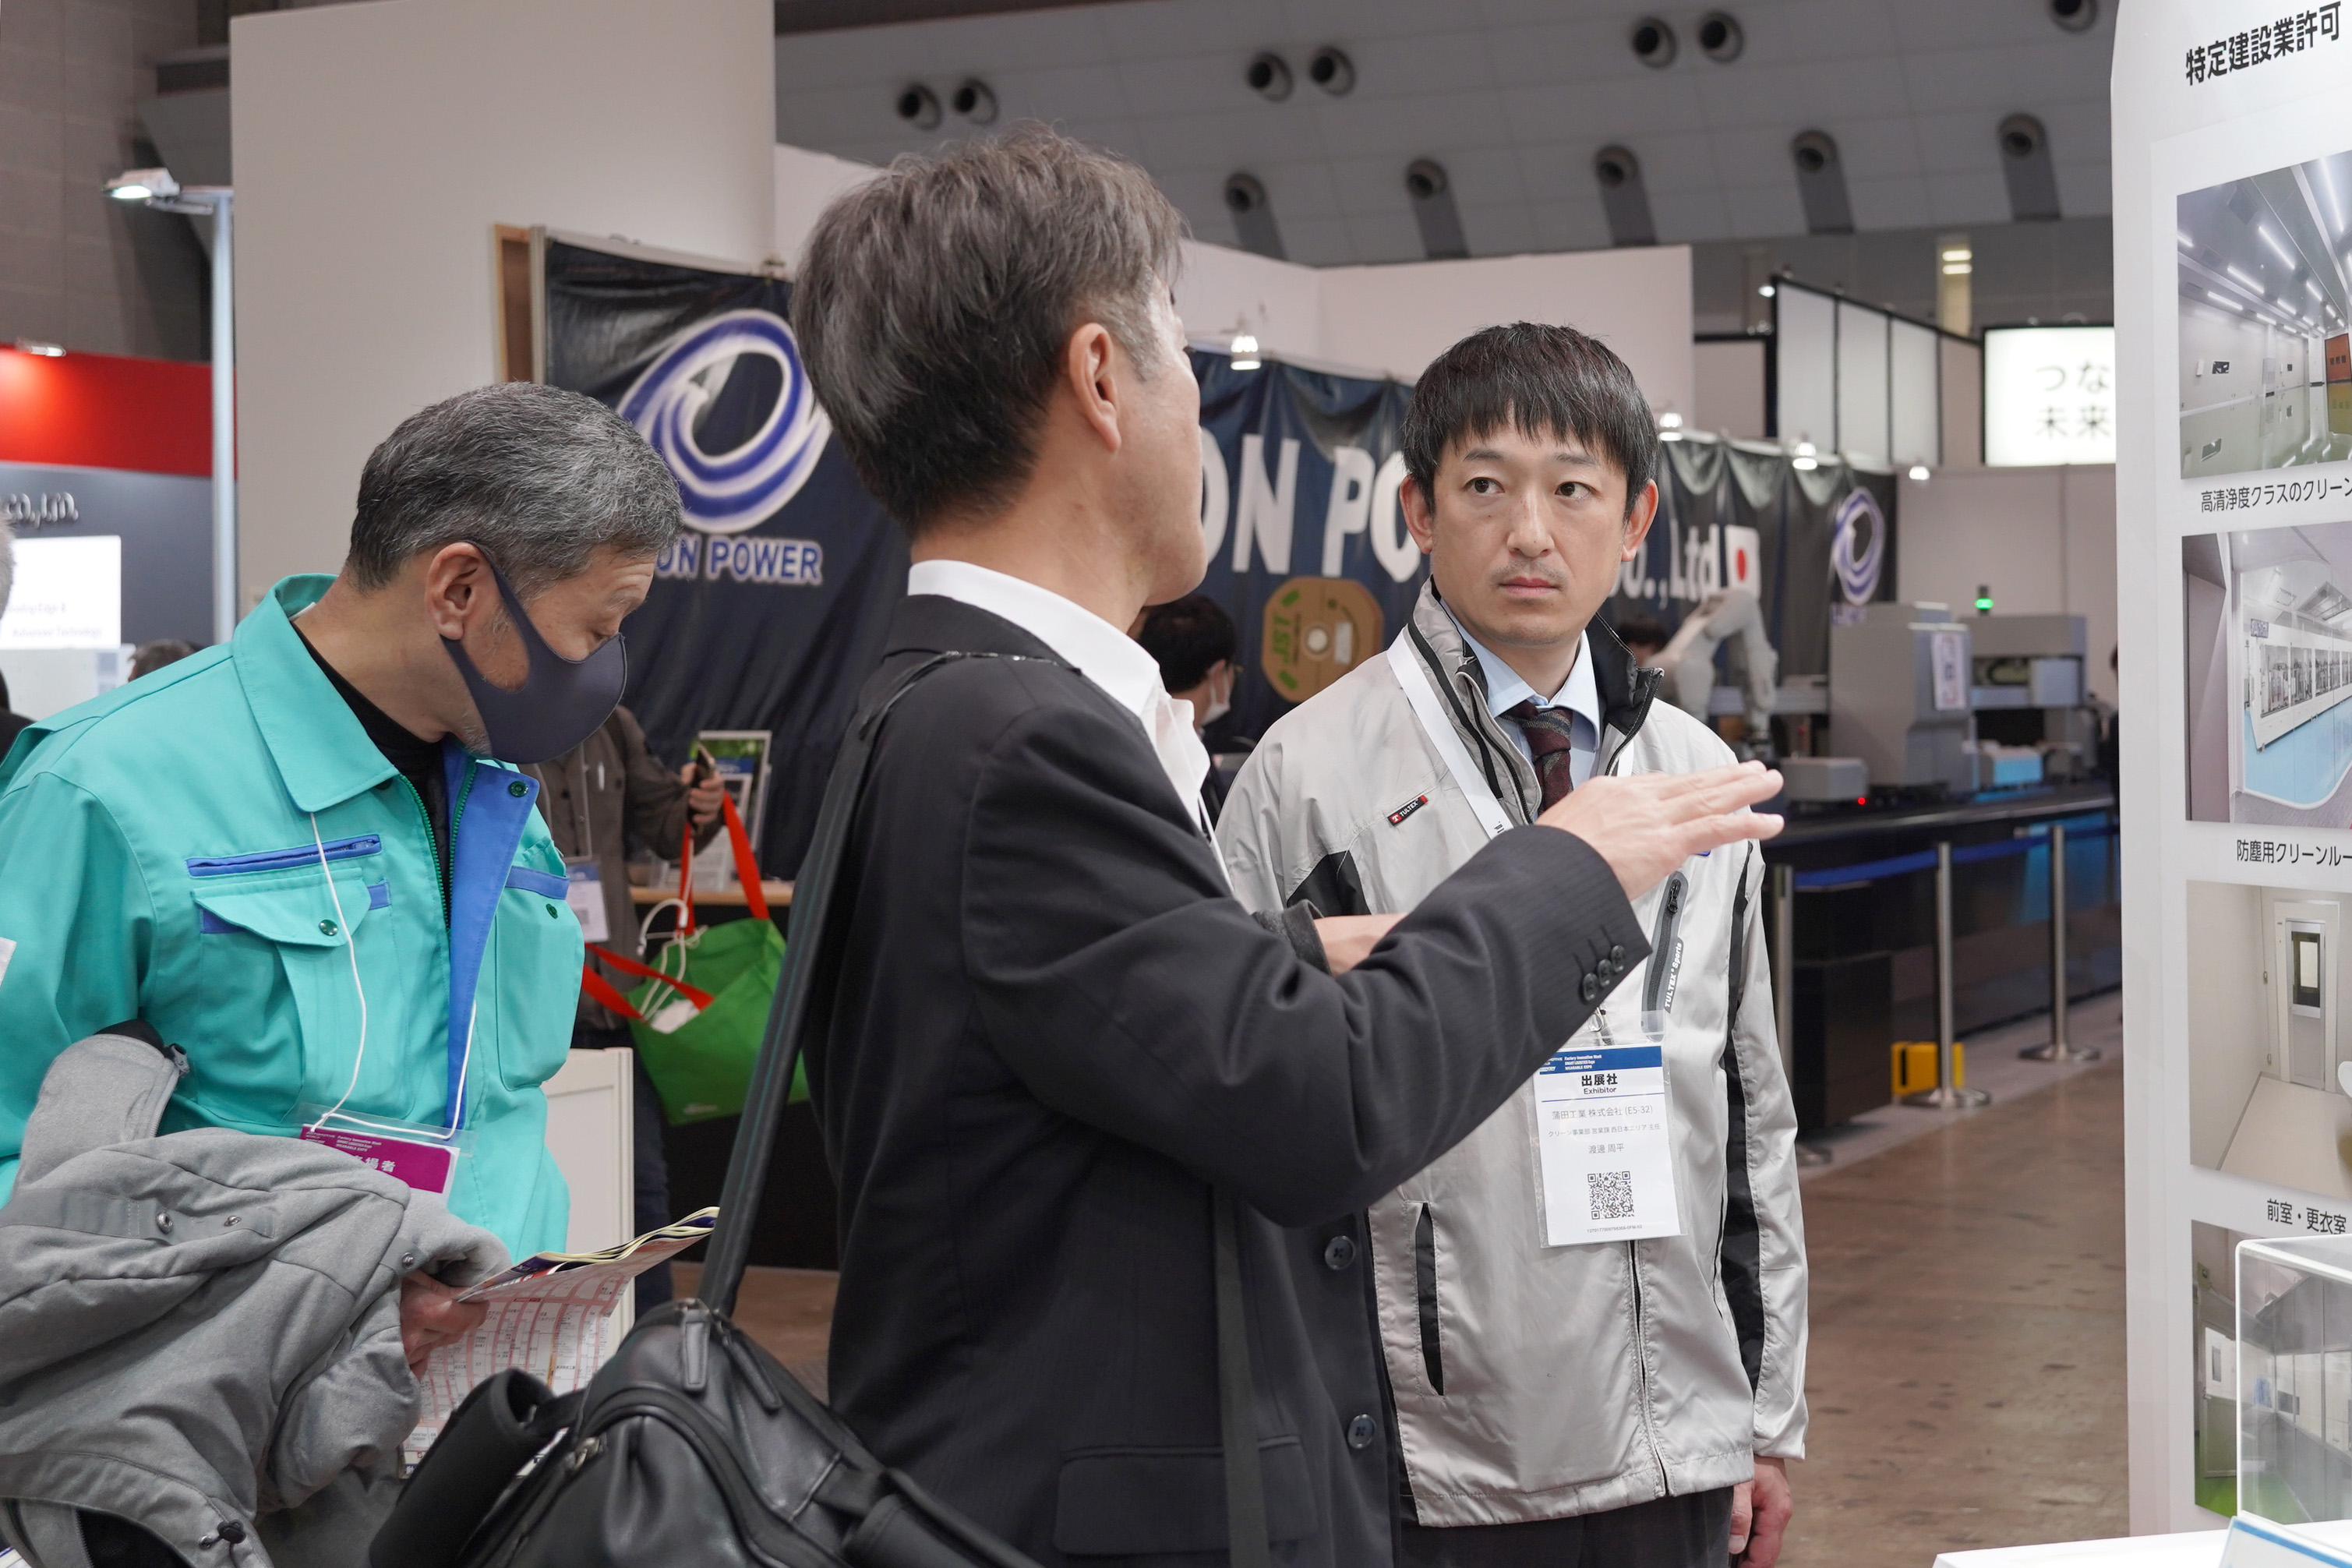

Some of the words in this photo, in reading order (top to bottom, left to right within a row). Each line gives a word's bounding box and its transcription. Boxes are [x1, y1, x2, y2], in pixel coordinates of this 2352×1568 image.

[2185, 2, 2341, 86] 特定建設業許可
[2036, 361, 2110, 393] つな
[2035, 404, 2112, 439] 未来
[2201, 478, 2352, 513] 高清浄度クラスのクリーン
[706, 534, 823, 586] POWER
[1400, 800, 1419, 818] TULTEX
[2237, 839, 2352, 866] 防塵用クリーンルー
[1672, 942, 1682, 969] Sports
[1581, 1073, 1618, 1086] 出展社
[1588, 1107, 1623, 1118] 株式会社
[1625, 1105, 1653, 1115] (E5-32)
[1608, 1143, 1625, 1153] 周平
[2267, 1198, 2347, 1234] 前室・更衣室
